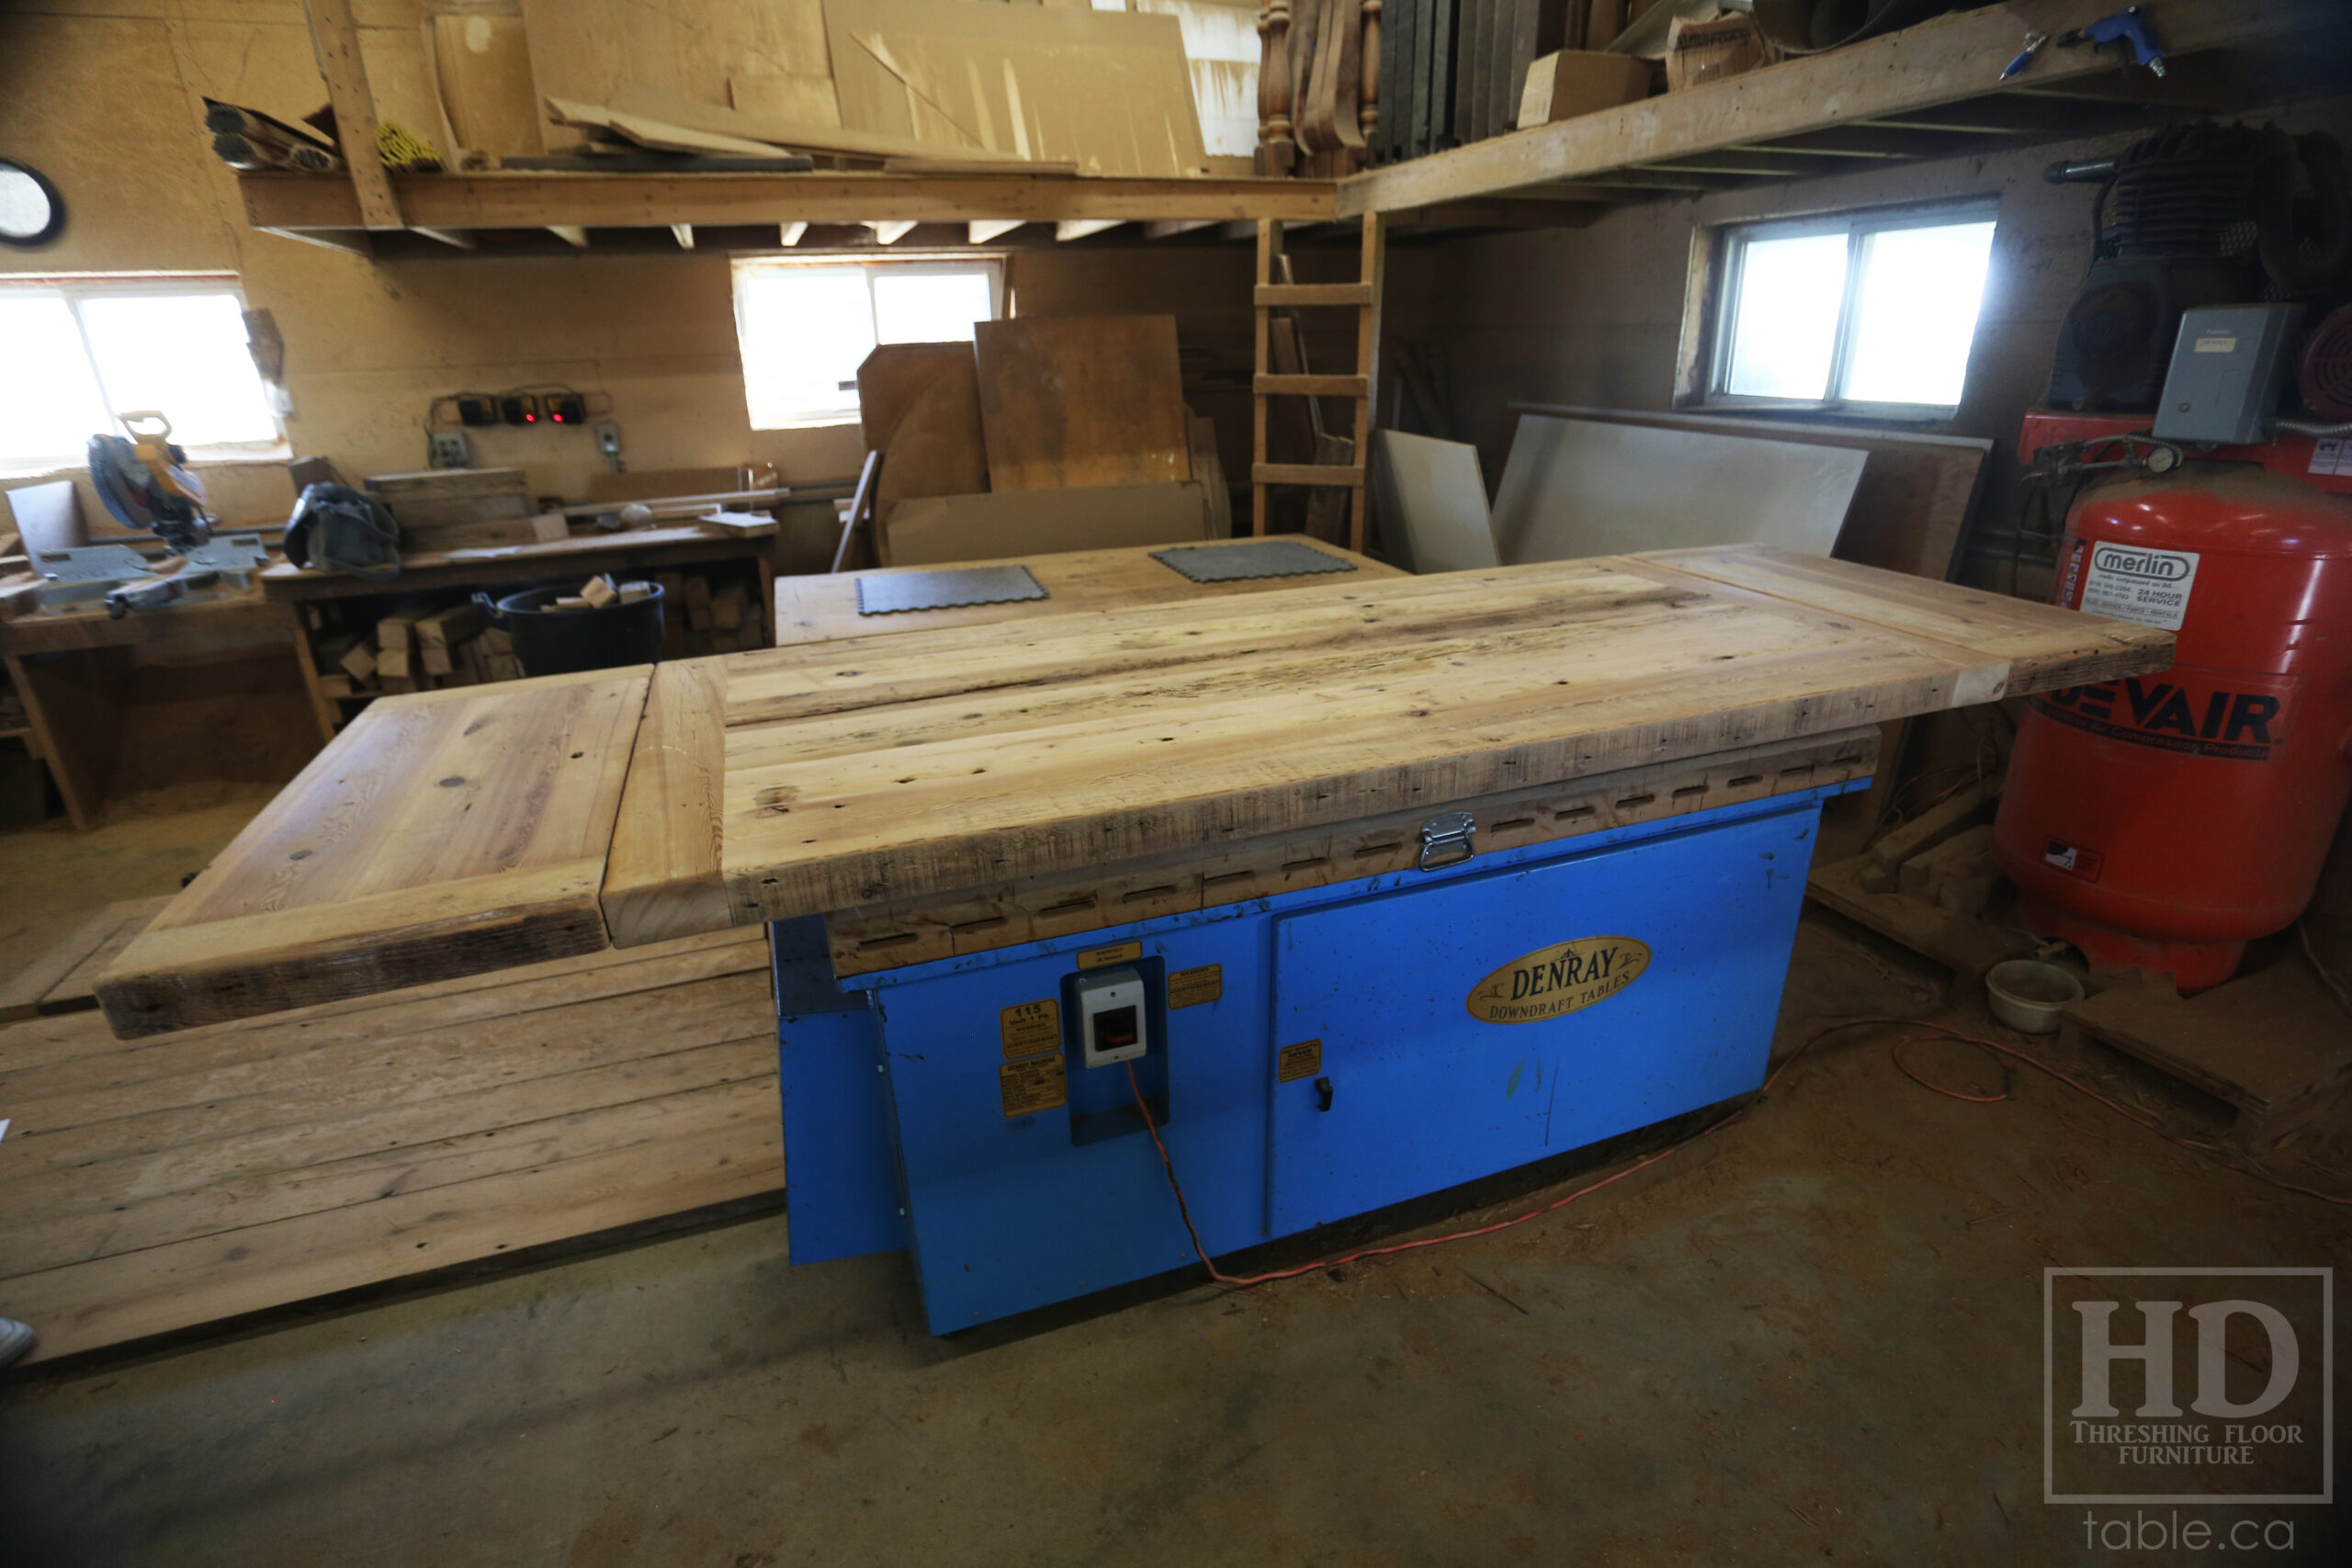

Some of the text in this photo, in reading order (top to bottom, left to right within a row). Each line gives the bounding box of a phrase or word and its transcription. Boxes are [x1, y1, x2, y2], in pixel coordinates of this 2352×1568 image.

[2103, 552, 2174, 576] merlin
[2136, 596, 2181, 606] SERVICE
[2153, 590, 2182, 599] HOUR
[2111, 727, 2268, 759] Compressor Products
[1510, 946, 1619, 1001] DENRAY
[1489, 971, 1631, 1020] DOWNDRAFT TABLES
[1014, 1004, 1042, 1017] 115
[1009, 1017, 1026, 1026] Volt
